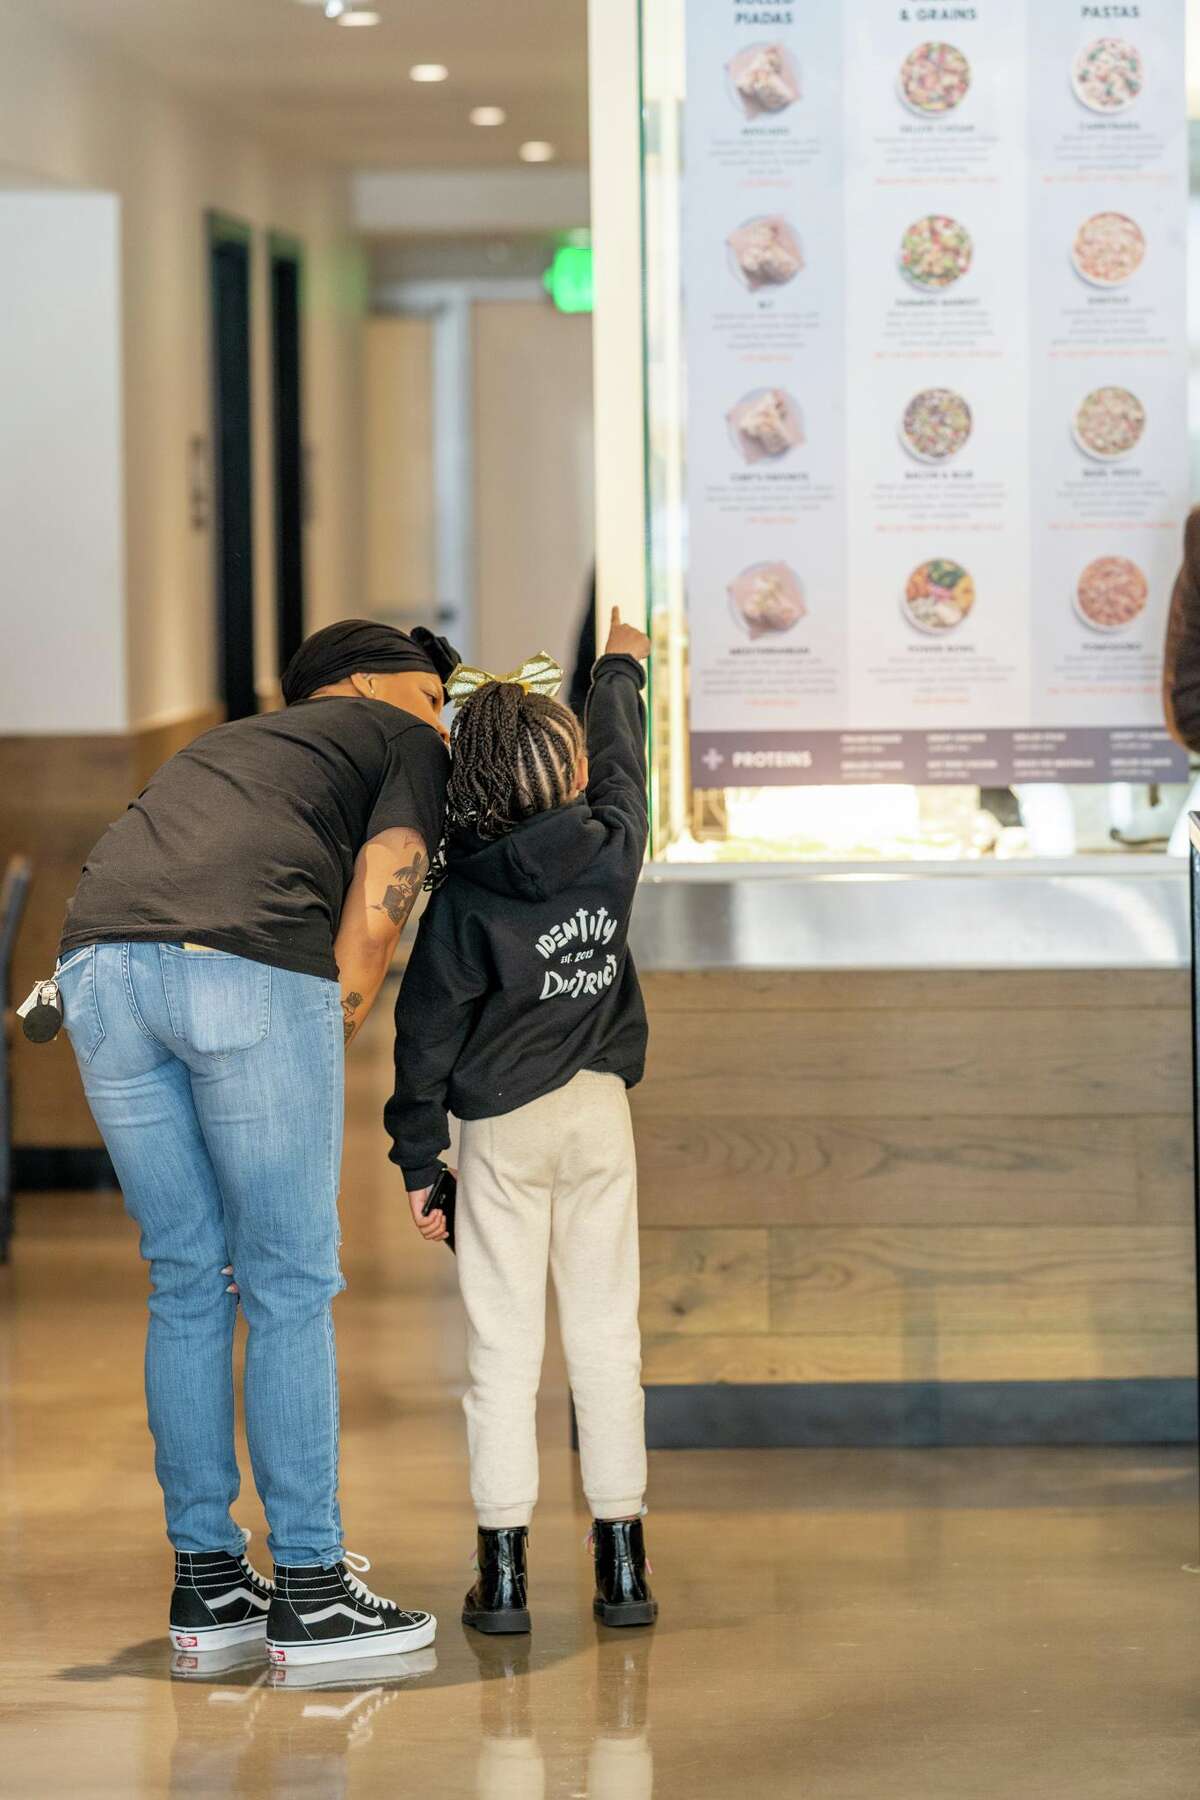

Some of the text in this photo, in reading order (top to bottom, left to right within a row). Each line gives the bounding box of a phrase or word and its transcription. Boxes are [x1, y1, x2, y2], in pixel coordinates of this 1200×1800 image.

[735, 12, 793, 25] PIADAS
[916, 8, 978, 21] GRAINS
[1081, 5, 1140, 19] PASTAS
[732, 751, 813, 769] PROTEINS
